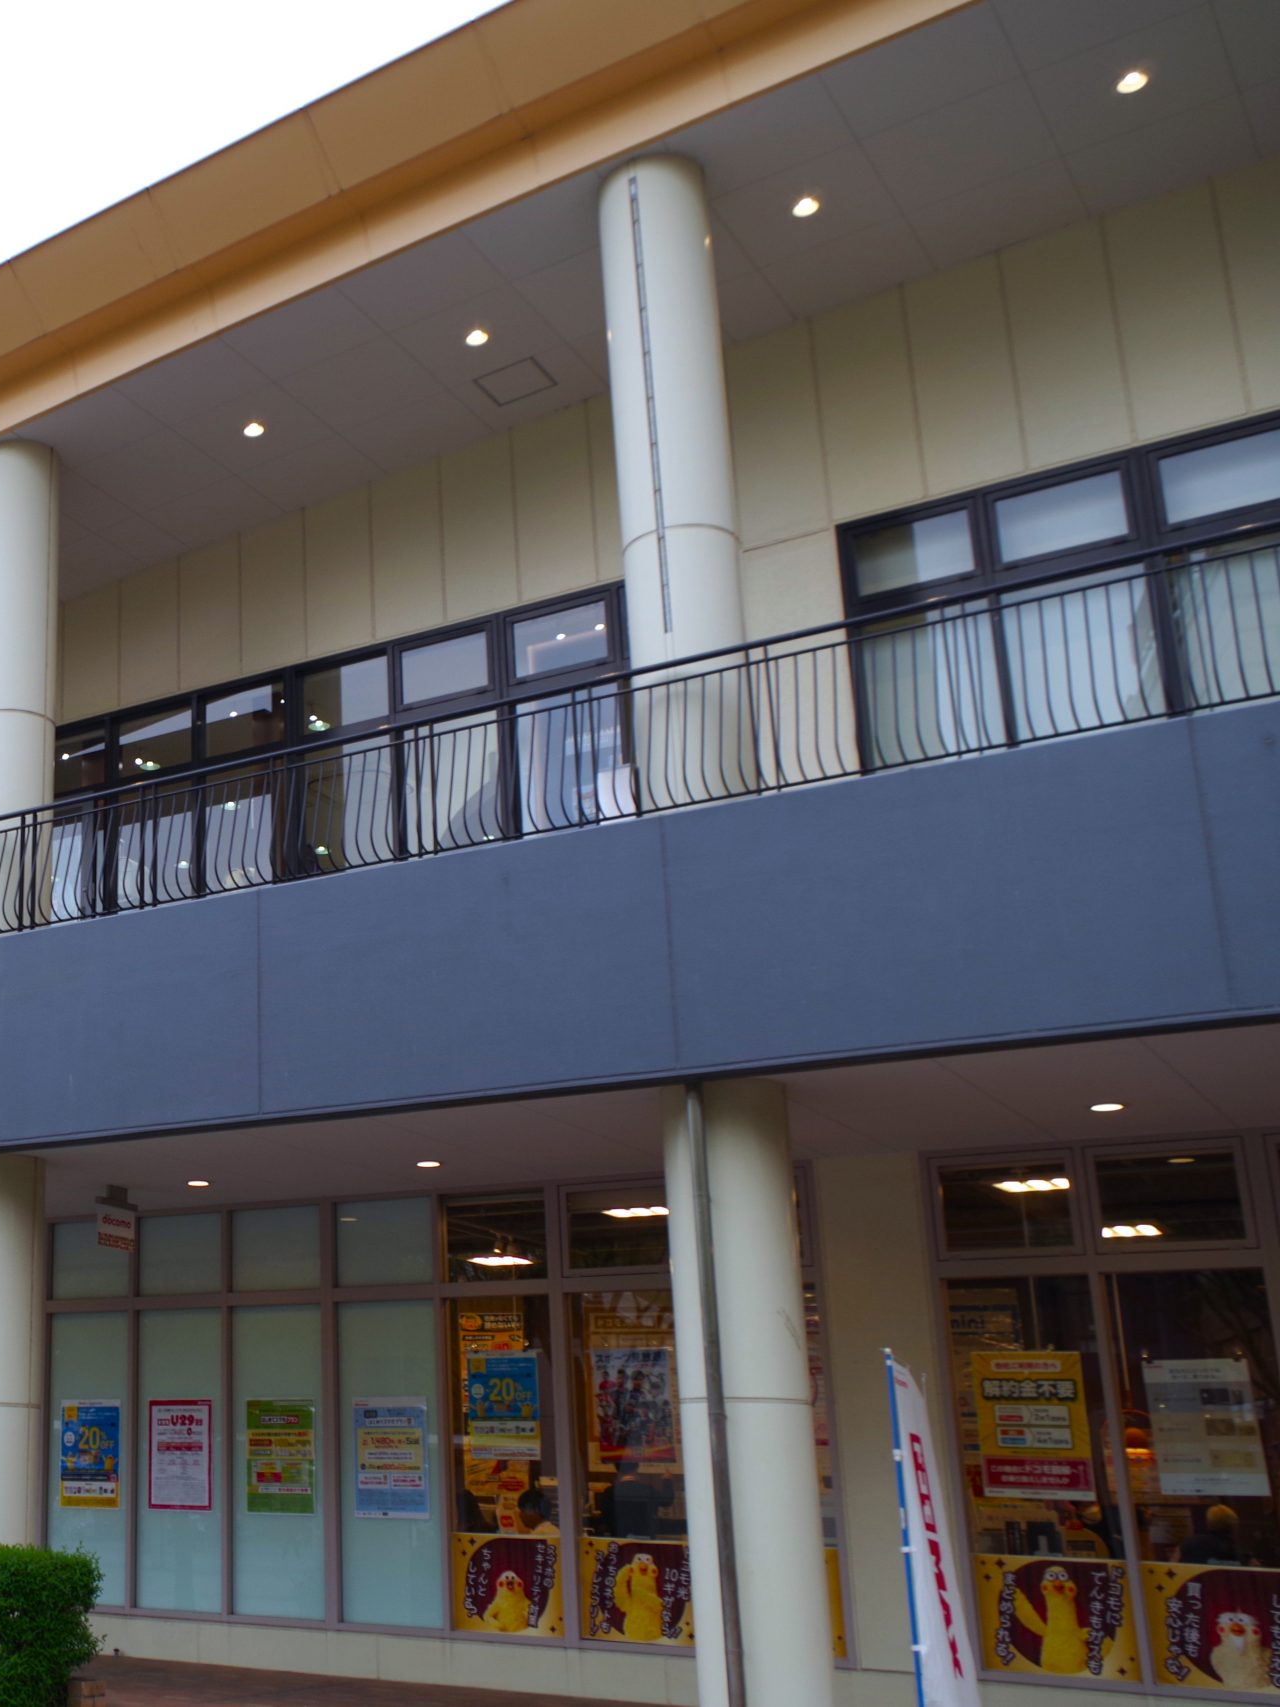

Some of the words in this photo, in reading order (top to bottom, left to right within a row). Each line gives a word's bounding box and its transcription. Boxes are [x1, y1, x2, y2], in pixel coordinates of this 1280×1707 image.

[102, 1215, 132, 1229] docomo
[170, 1414, 195, 1426] U29
[982, 1379, 1075, 1399] 解約金不要
[478, 1548, 492, 1597] ちゃんと
[528, 1542, 545, 1627] セキュリティ対策
[543, 1544, 556, 1588] スマホの
[600, 1542, 619, 1634] おうちのネットも
[927, 1538, 964, 1679] MAX
[1087, 1570, 1106, 1674] でんきもガスも
[1182, 1581, 1203, 1658] 買った後も
